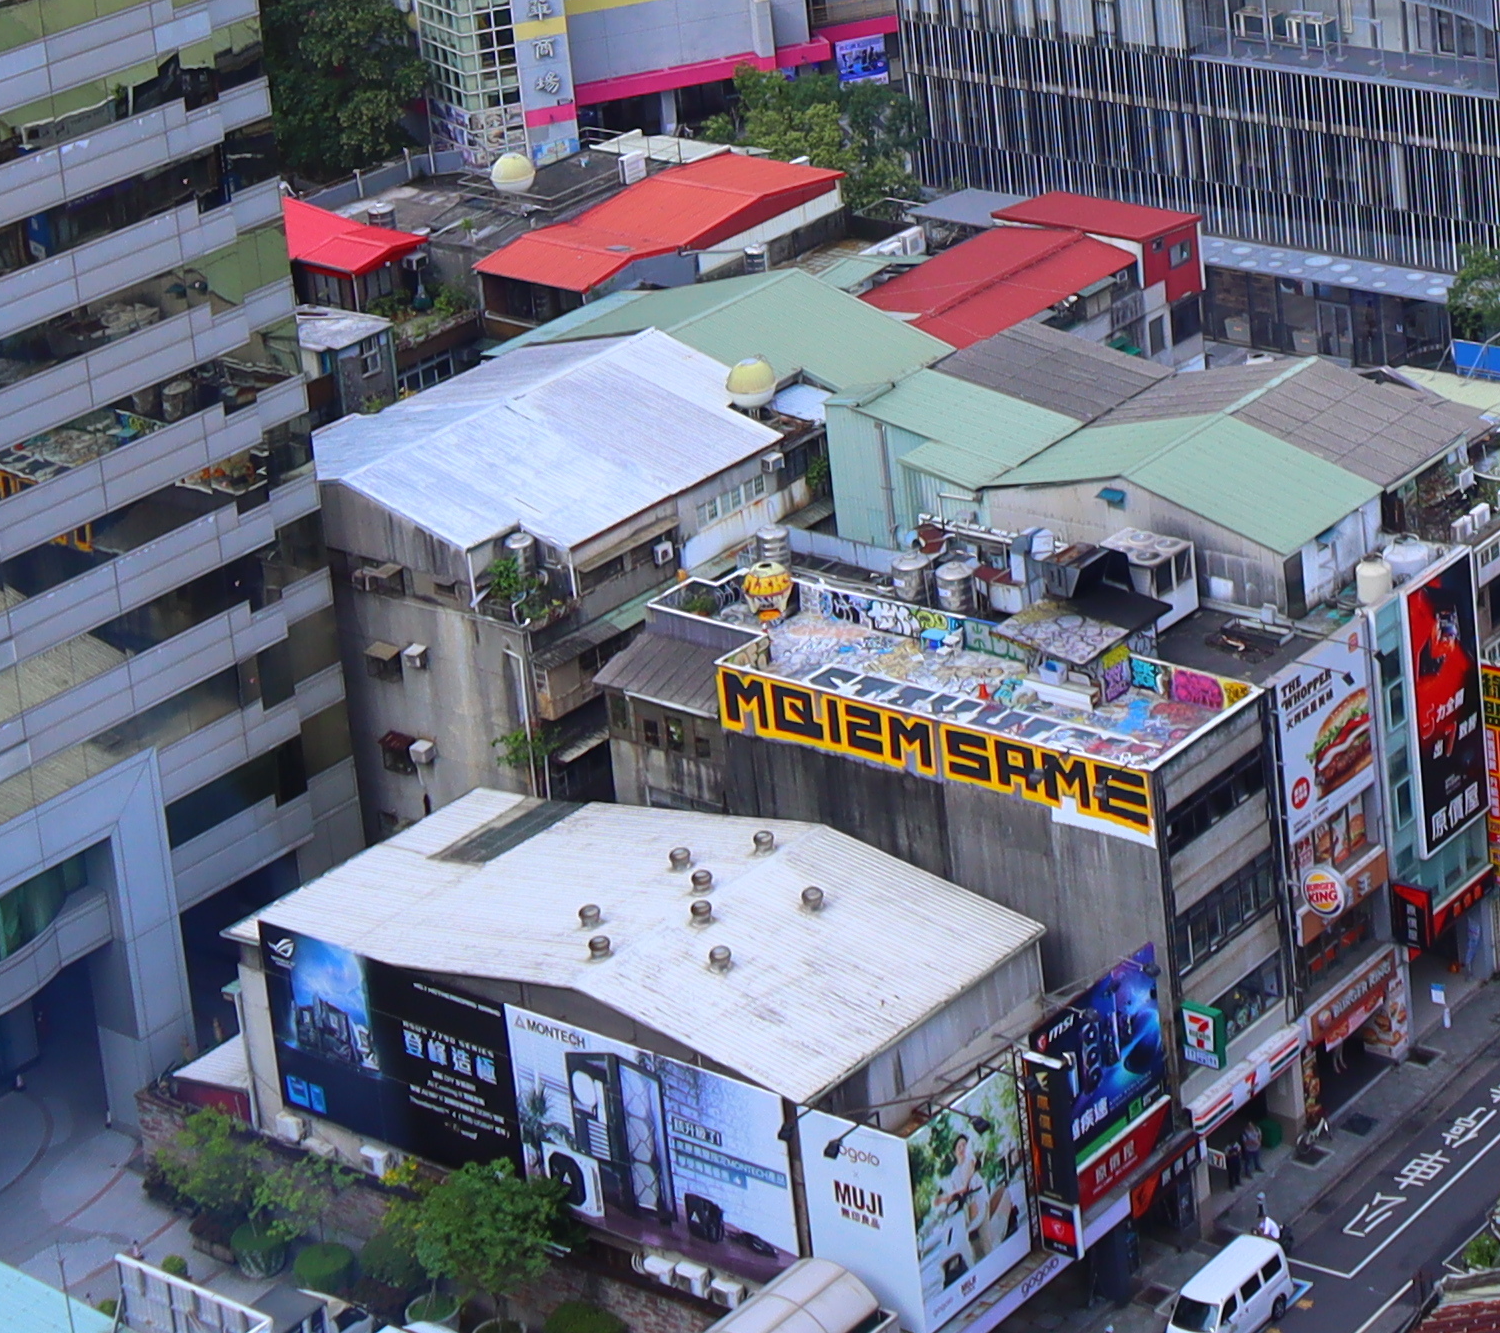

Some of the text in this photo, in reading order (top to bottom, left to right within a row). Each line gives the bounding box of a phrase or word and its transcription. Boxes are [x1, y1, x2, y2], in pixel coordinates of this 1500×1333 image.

[1280, 674, 1302, 699] THE
[1280, 668, 1332, 712] WHOPPER
[945, 728, 1150, 829] SAME
[1431, 781, 1480, 842] 原價屋
[1305, 881, 1337, 892] BURGER
[1307, 890, 1338, 903] KING
[526, 1018, 586, 1049] MONTECH
[402, 1028, 499, 1087] 登峰造極
[839, 1144, 880, 1167] ogoro
[833, 1179, 884, 1218] MUJI
[1020, 1256, 1060, 1299] gogoro
